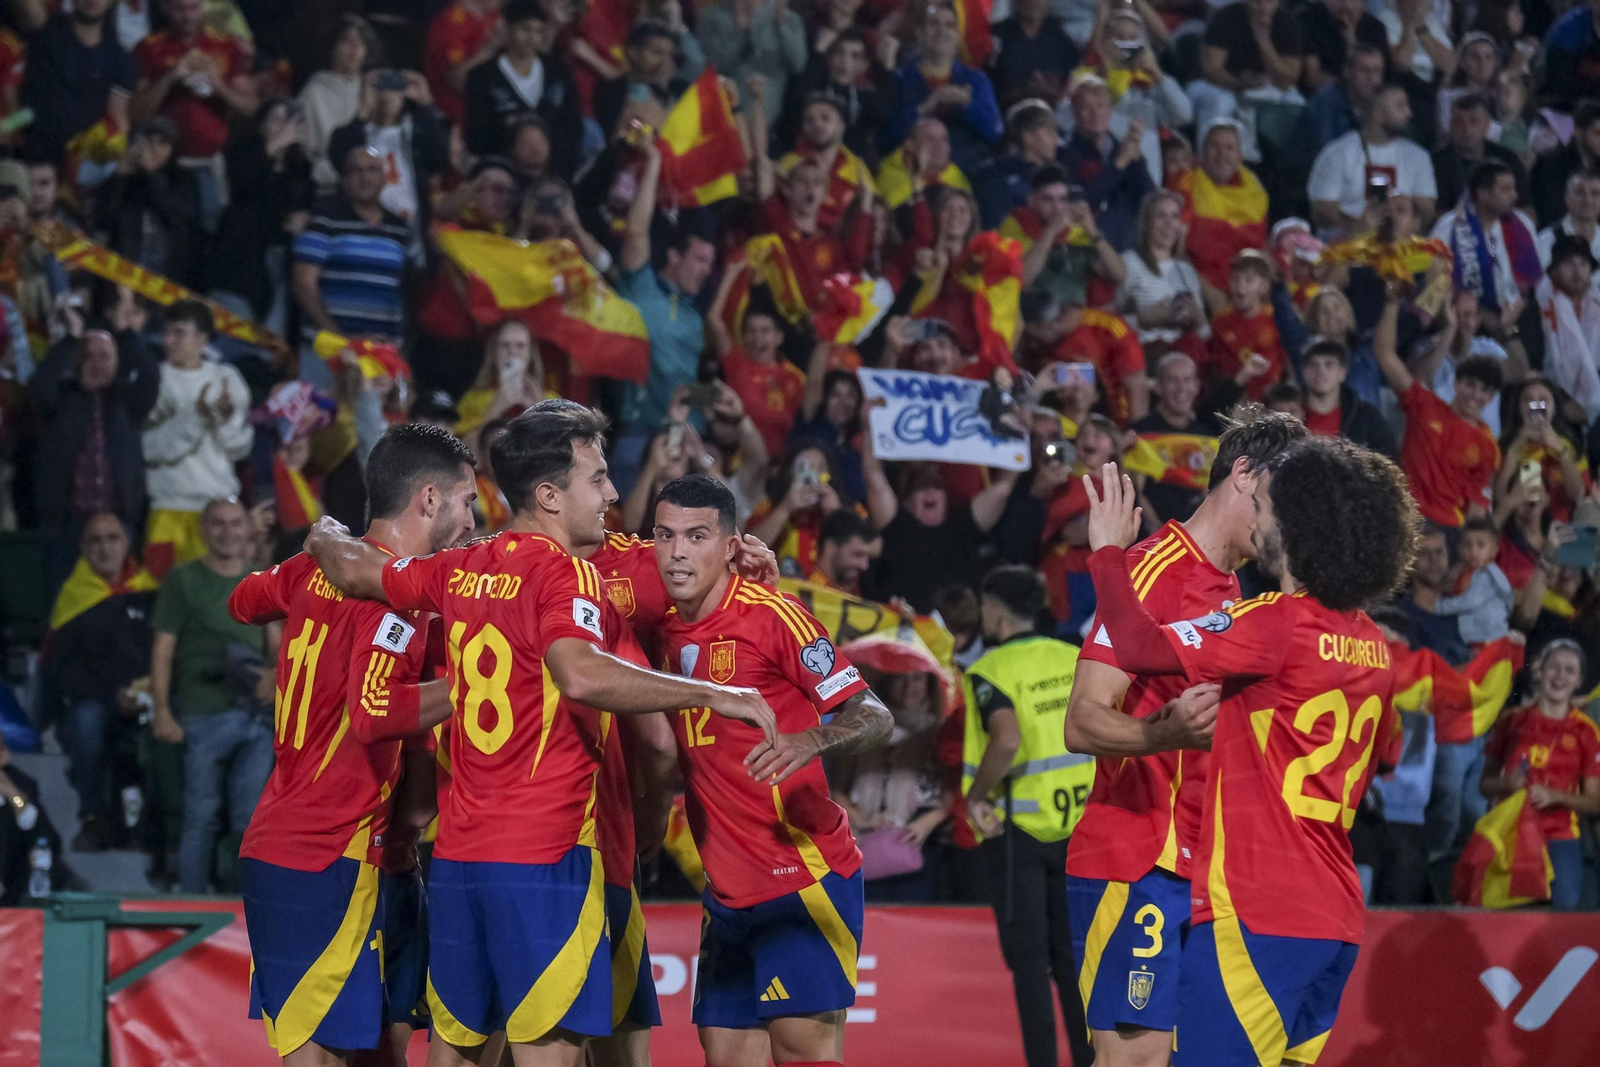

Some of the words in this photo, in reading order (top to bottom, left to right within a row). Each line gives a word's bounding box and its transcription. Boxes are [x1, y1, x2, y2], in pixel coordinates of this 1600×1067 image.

[279, 617, 329, 750] 11
[448, 620, 514, 756] 18
[679, 706, 716, 748] 12
[1282, 689, 1382, 829] 22
[1133, 904, 1164, 958] 3
